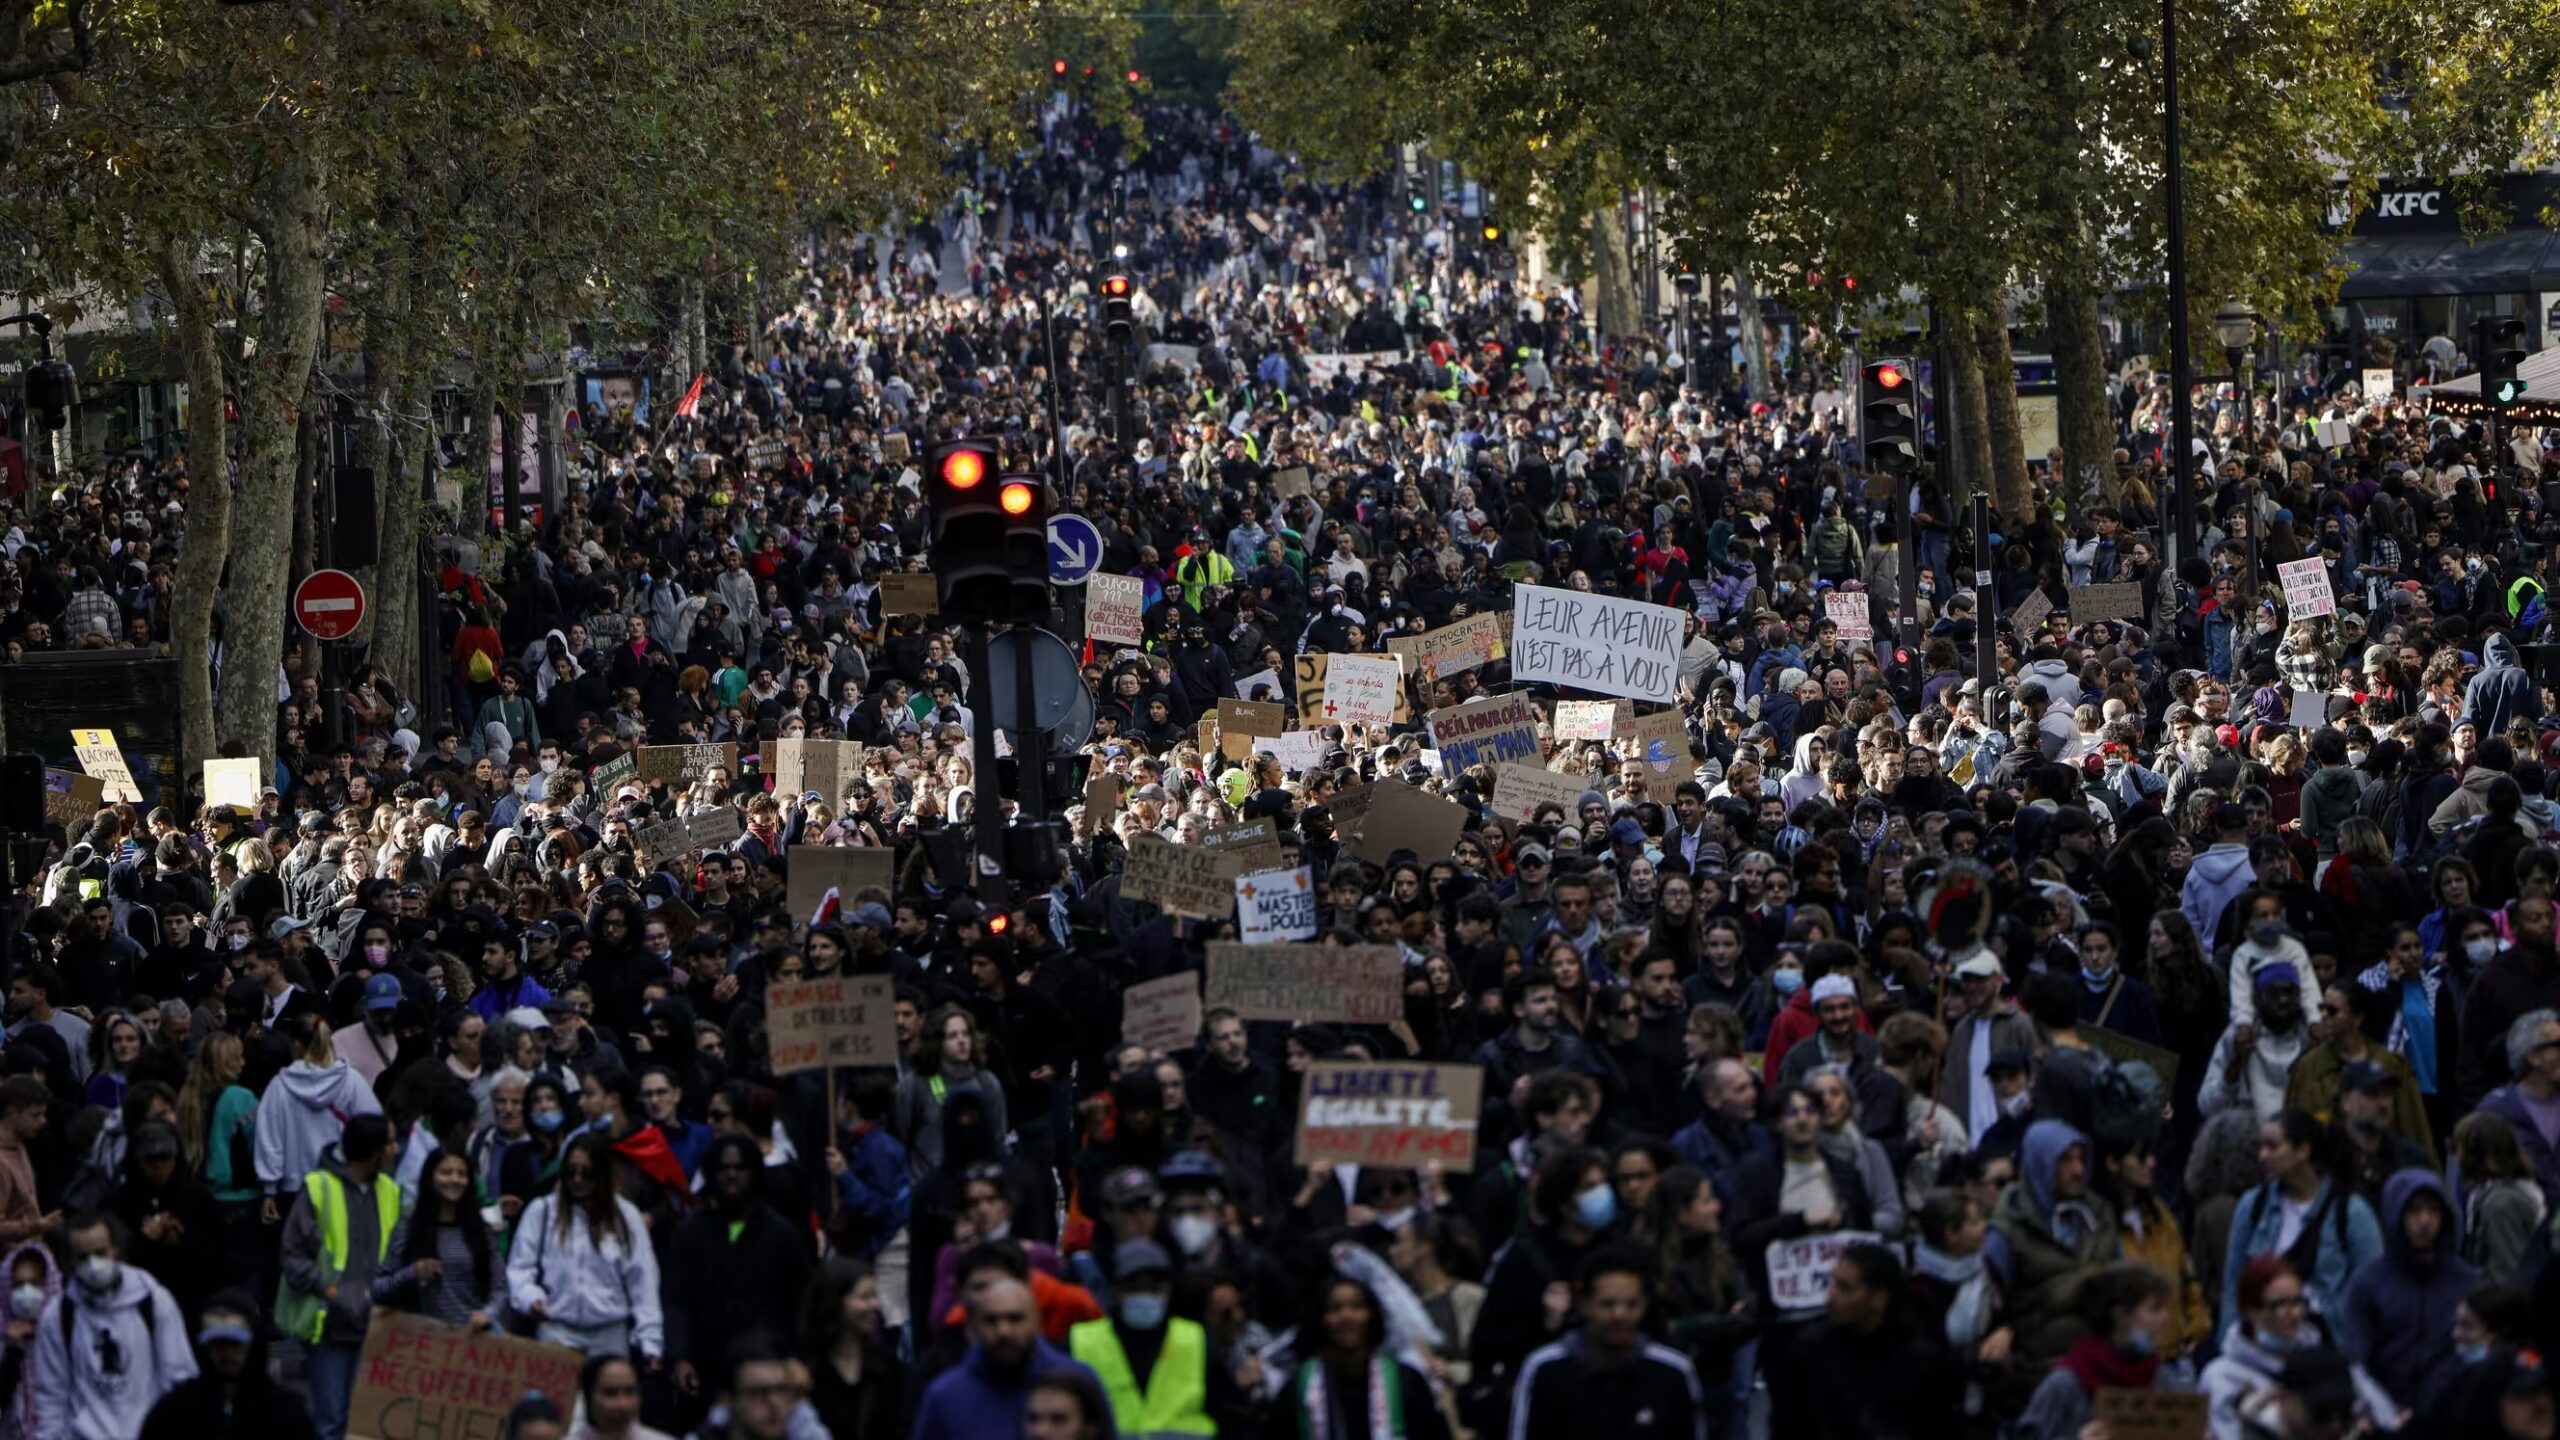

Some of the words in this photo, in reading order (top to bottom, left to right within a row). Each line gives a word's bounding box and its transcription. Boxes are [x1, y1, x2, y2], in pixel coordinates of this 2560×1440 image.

[2378, 191, 2440, 218] KFC
[2364, 316, 2398, 331] SAUCY
[1425, 619, 1491, 649] DÉMOCRATIE
[1523, 593, 1583, 639] LEUR
[1590, 604, 1677, 662] AVENIR
[1516, 638, 1560, 673] N'EST
[1562, 646, 1592, 679] PAS
[1596, 643, 1614, 684] À
[1622, 653, 1670, 698] VOUS
[1235, 707, 1255, 717] BLANC
[1346, 710, 1393, 725] international
[1467, 709, 1502, 732] POUR
[687, 755, 725, 767] PARENTS
[704, 745, 723, 756] NOS
[1438, 738, 1481, 780] MAIN
[1494, 726, 1537, 762] MAIN
[1204, 834, 1221, 846] ON
[1311, 1065, 1438, 1096] LIBERTÉ
[387, 1326, 517, 1375] PÉTAIN
